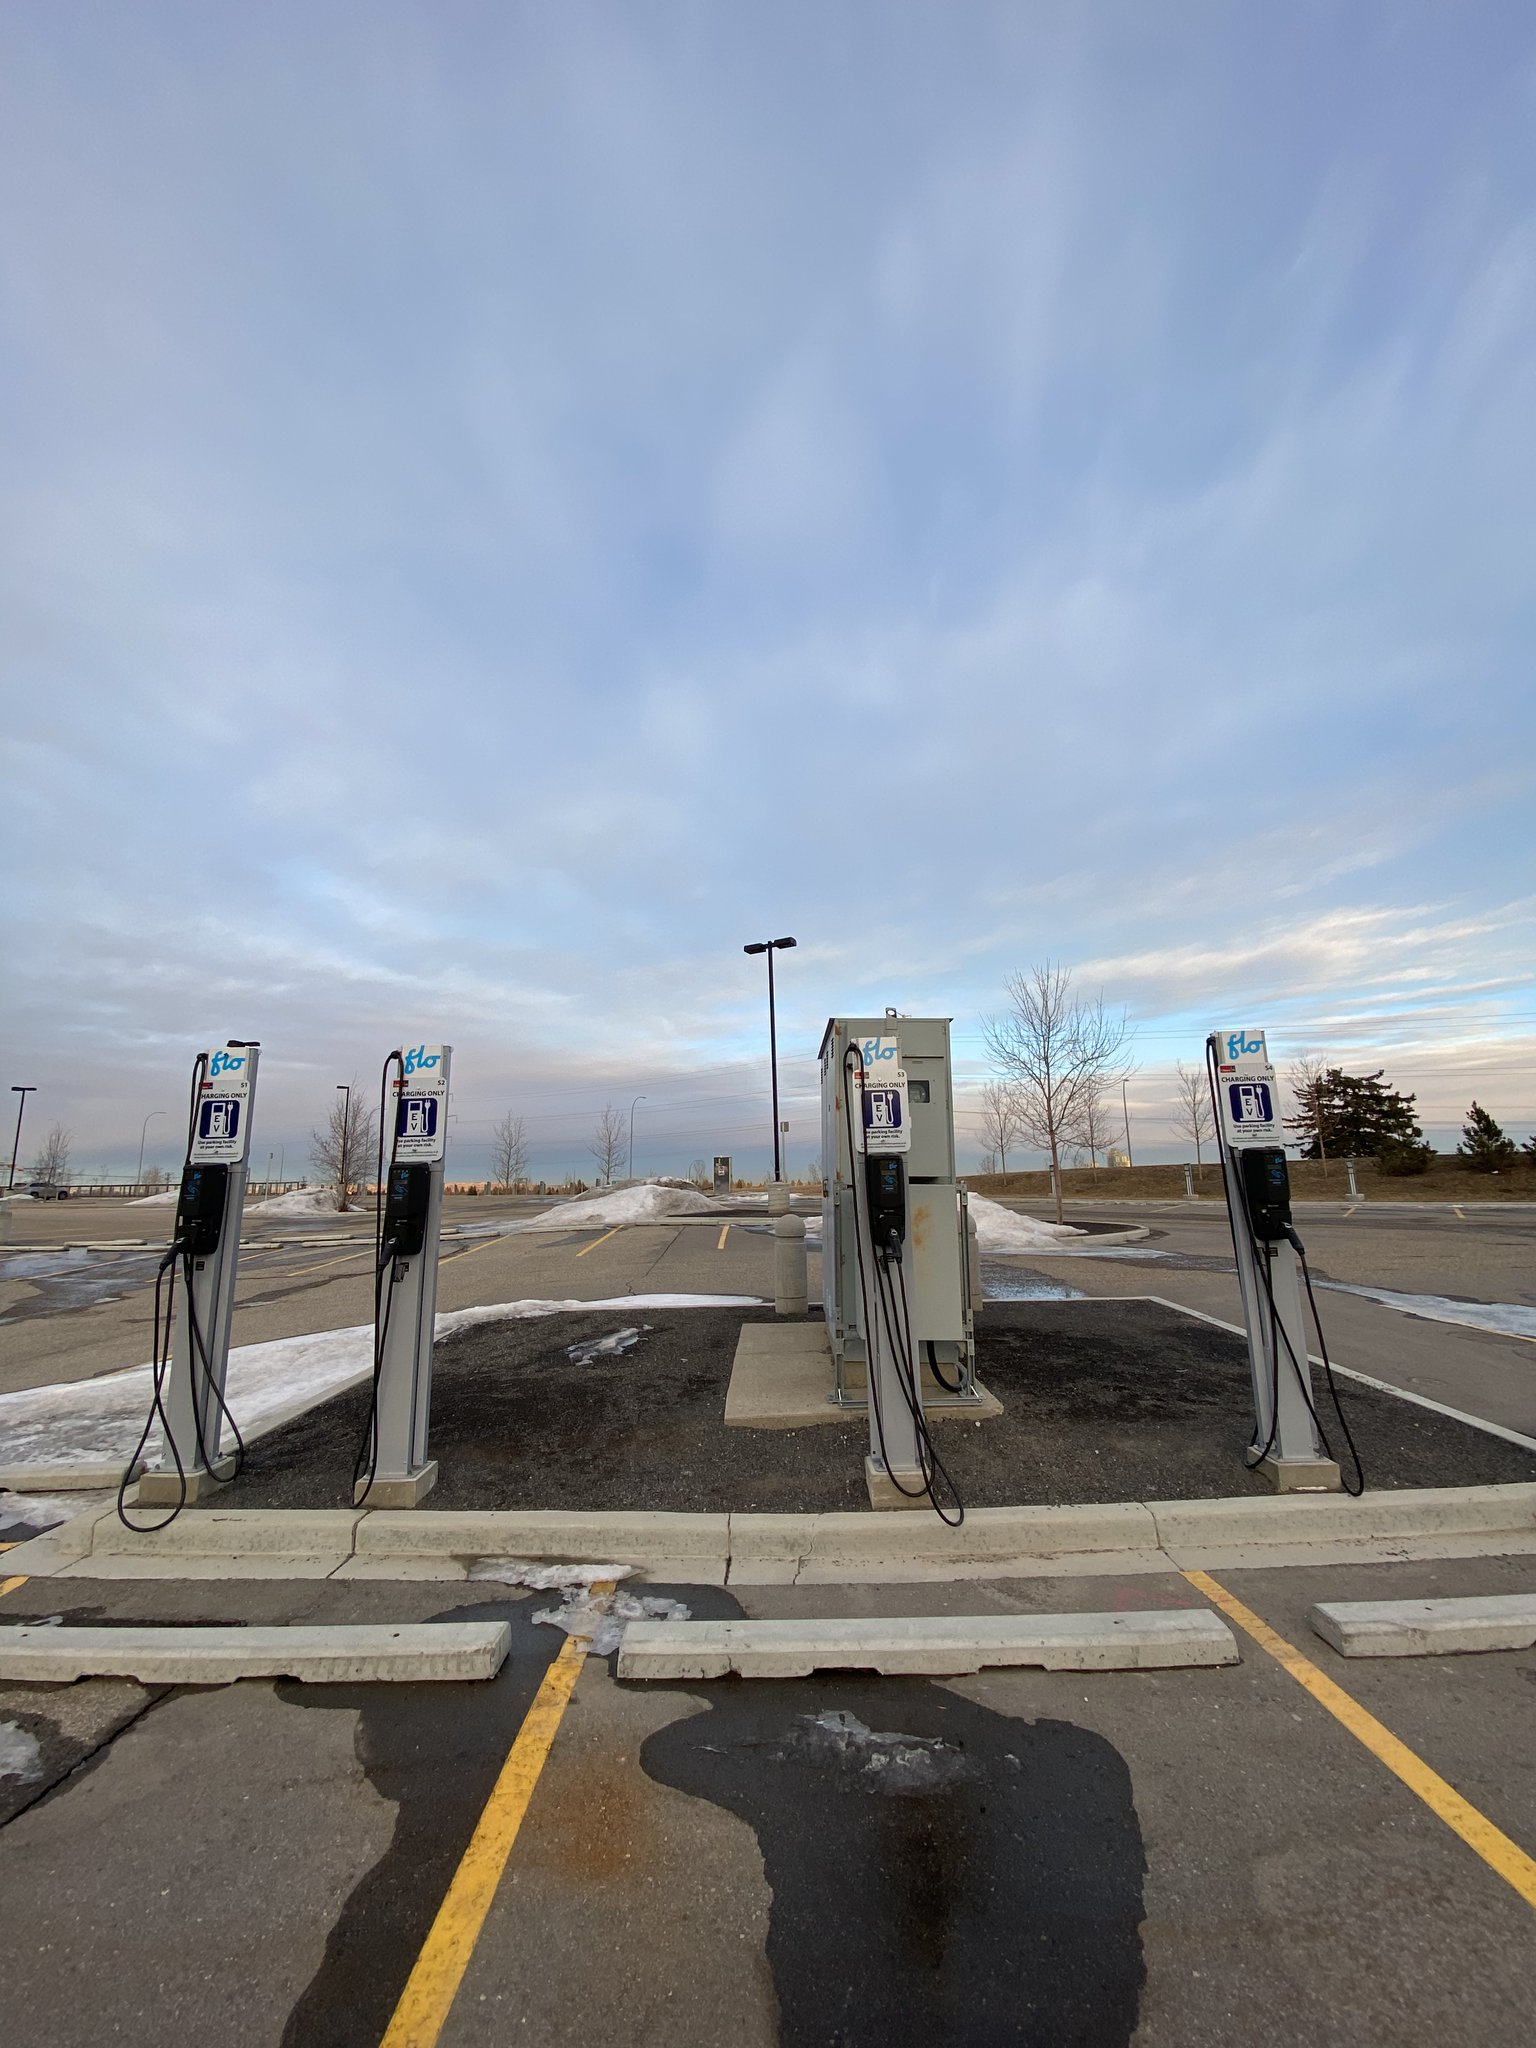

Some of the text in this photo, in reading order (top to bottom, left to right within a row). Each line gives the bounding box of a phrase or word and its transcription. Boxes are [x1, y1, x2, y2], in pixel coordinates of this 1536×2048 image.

[405, 1045, 441, 1074] flo
[863, 1036, 896, 1066] flo
[1227, 1031, 1264, 1060] flo
